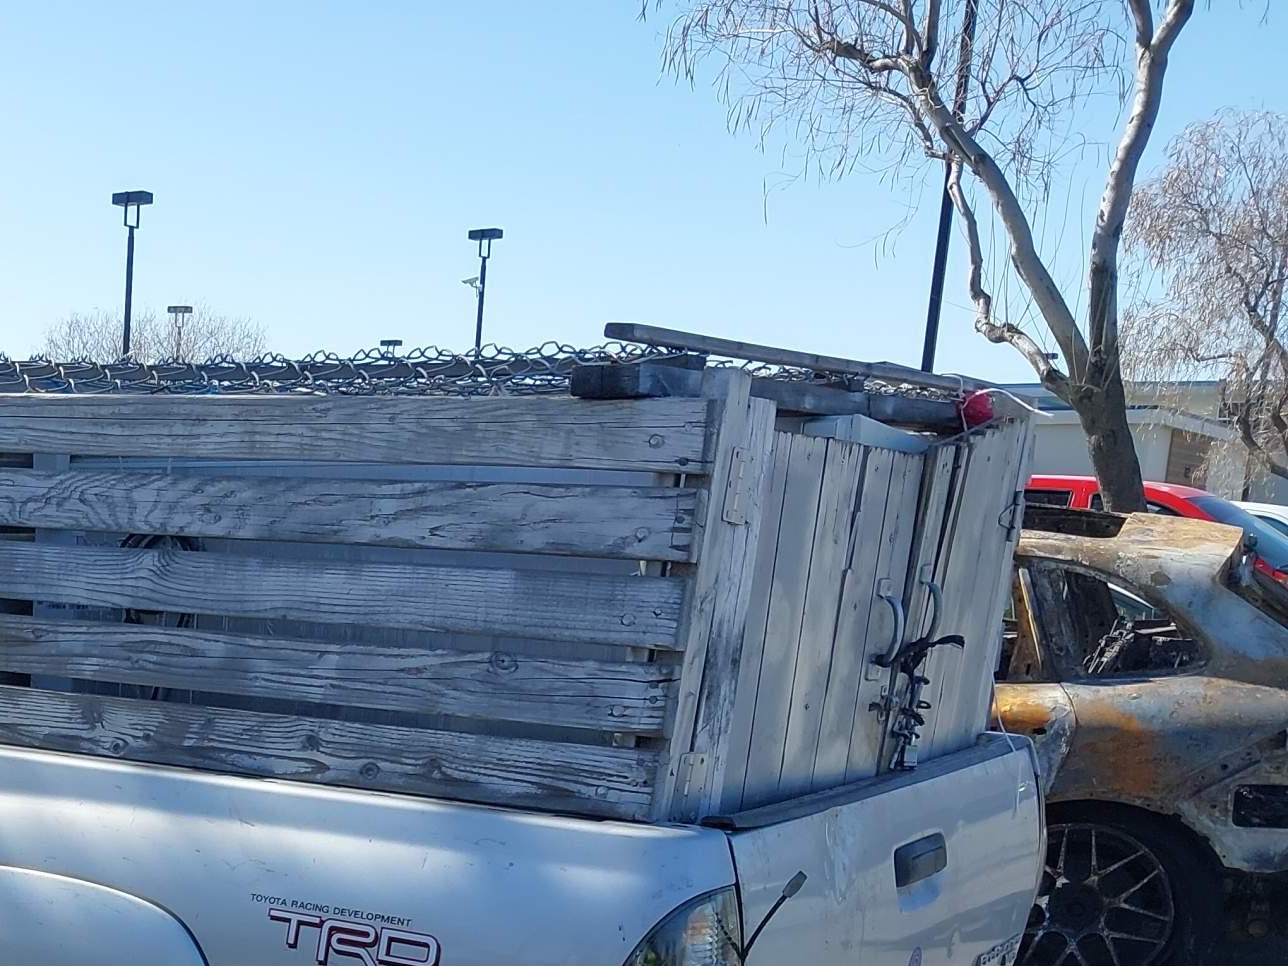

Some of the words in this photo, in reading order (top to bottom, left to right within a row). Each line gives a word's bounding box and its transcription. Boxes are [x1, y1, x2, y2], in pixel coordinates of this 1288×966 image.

[250, 893, 288, 908] TOYOTA
[290, 899, 330, 915] RACING
[332, 907, 413, 928] DEVELOPMENT
